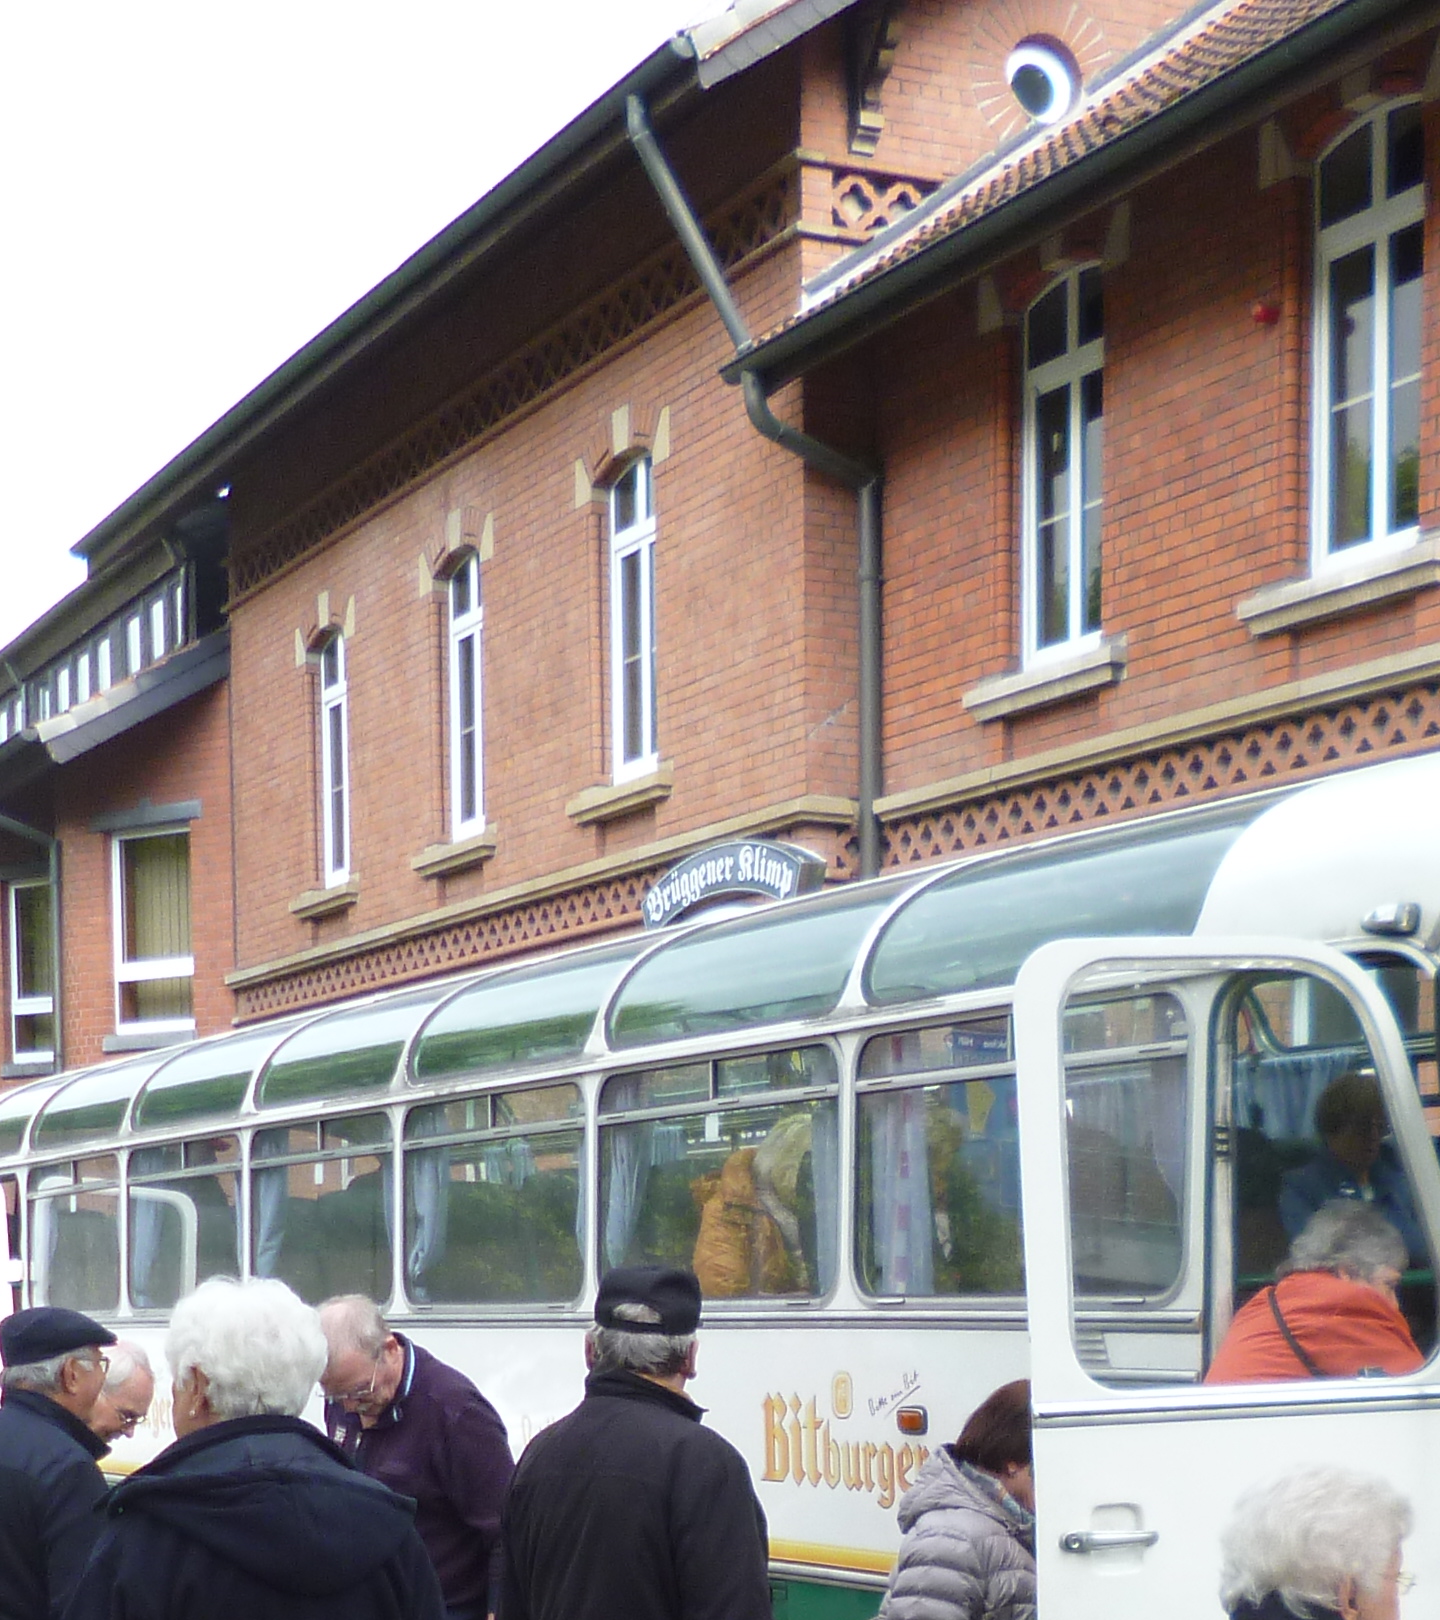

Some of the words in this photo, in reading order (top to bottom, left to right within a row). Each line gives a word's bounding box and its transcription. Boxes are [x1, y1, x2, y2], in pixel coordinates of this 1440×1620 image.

[646, 855, 735, 921] Brüggener
[738, 845, 793, 899] Klimp
[761, 1391, 929, 1509] Bitburger
